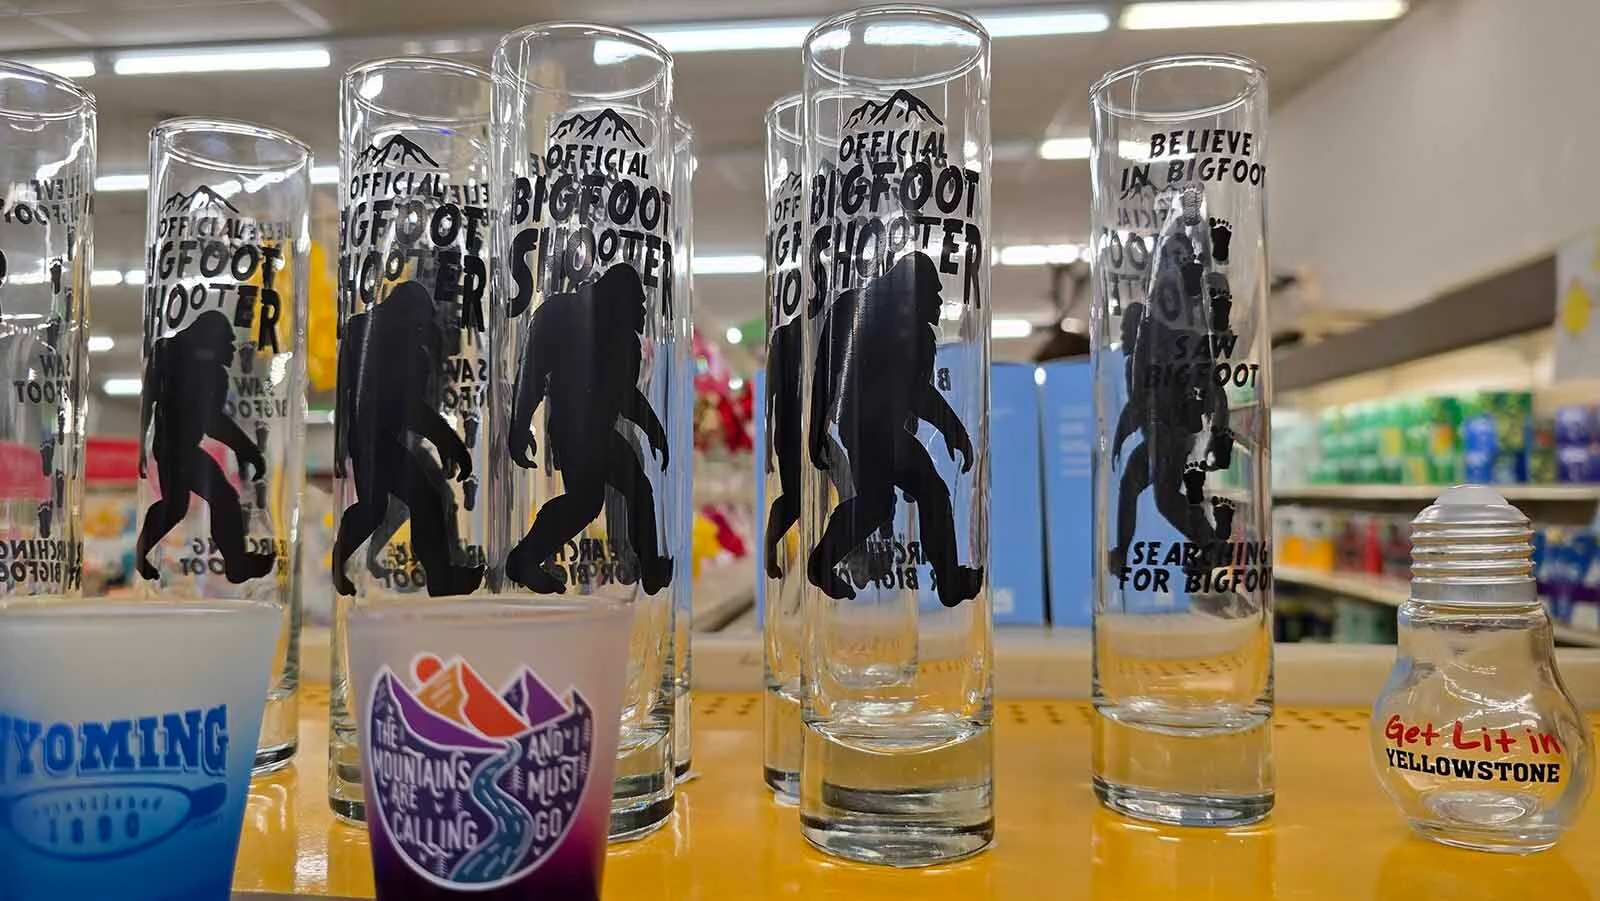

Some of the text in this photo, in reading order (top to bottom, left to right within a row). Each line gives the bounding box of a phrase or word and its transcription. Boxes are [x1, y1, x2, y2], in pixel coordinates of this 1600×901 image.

[547, 144, 649, 179] OFFICIAL
[839, 130, 948, 163] OFFICIAL
[1151, 129, 1253, 158] BELIEVE
[350, 172, 443, 199] OFFICIAL
[810, 162, 980, 225] BIGFOOT
[1120, 157, 1266, 194] IN BIGFOOT
[511, 174, 671, 236] BIGFOOT
[159, 216, 243, 239] OFFICIAL
[507, 228, 674, 320] SHOOTER
[807, 215, 983, 320] SHOOTER
[1119, 566, 1170, 593] FOR
[375, 718, 398, 748] THE
[525, 722, 564, 765] AND
[1385, 715, 1562, 754] Get Lit in
[373, 746, 472, 797] MOUNTAINS
[526, 755, 580, 805] MUST
[1386, 747, 1560, 783] YELLOWSTONE
[389, 782, 418, 813] ARE
[393, 810, 478, 857] CALLING
[533, 807, 563, 842] GO
